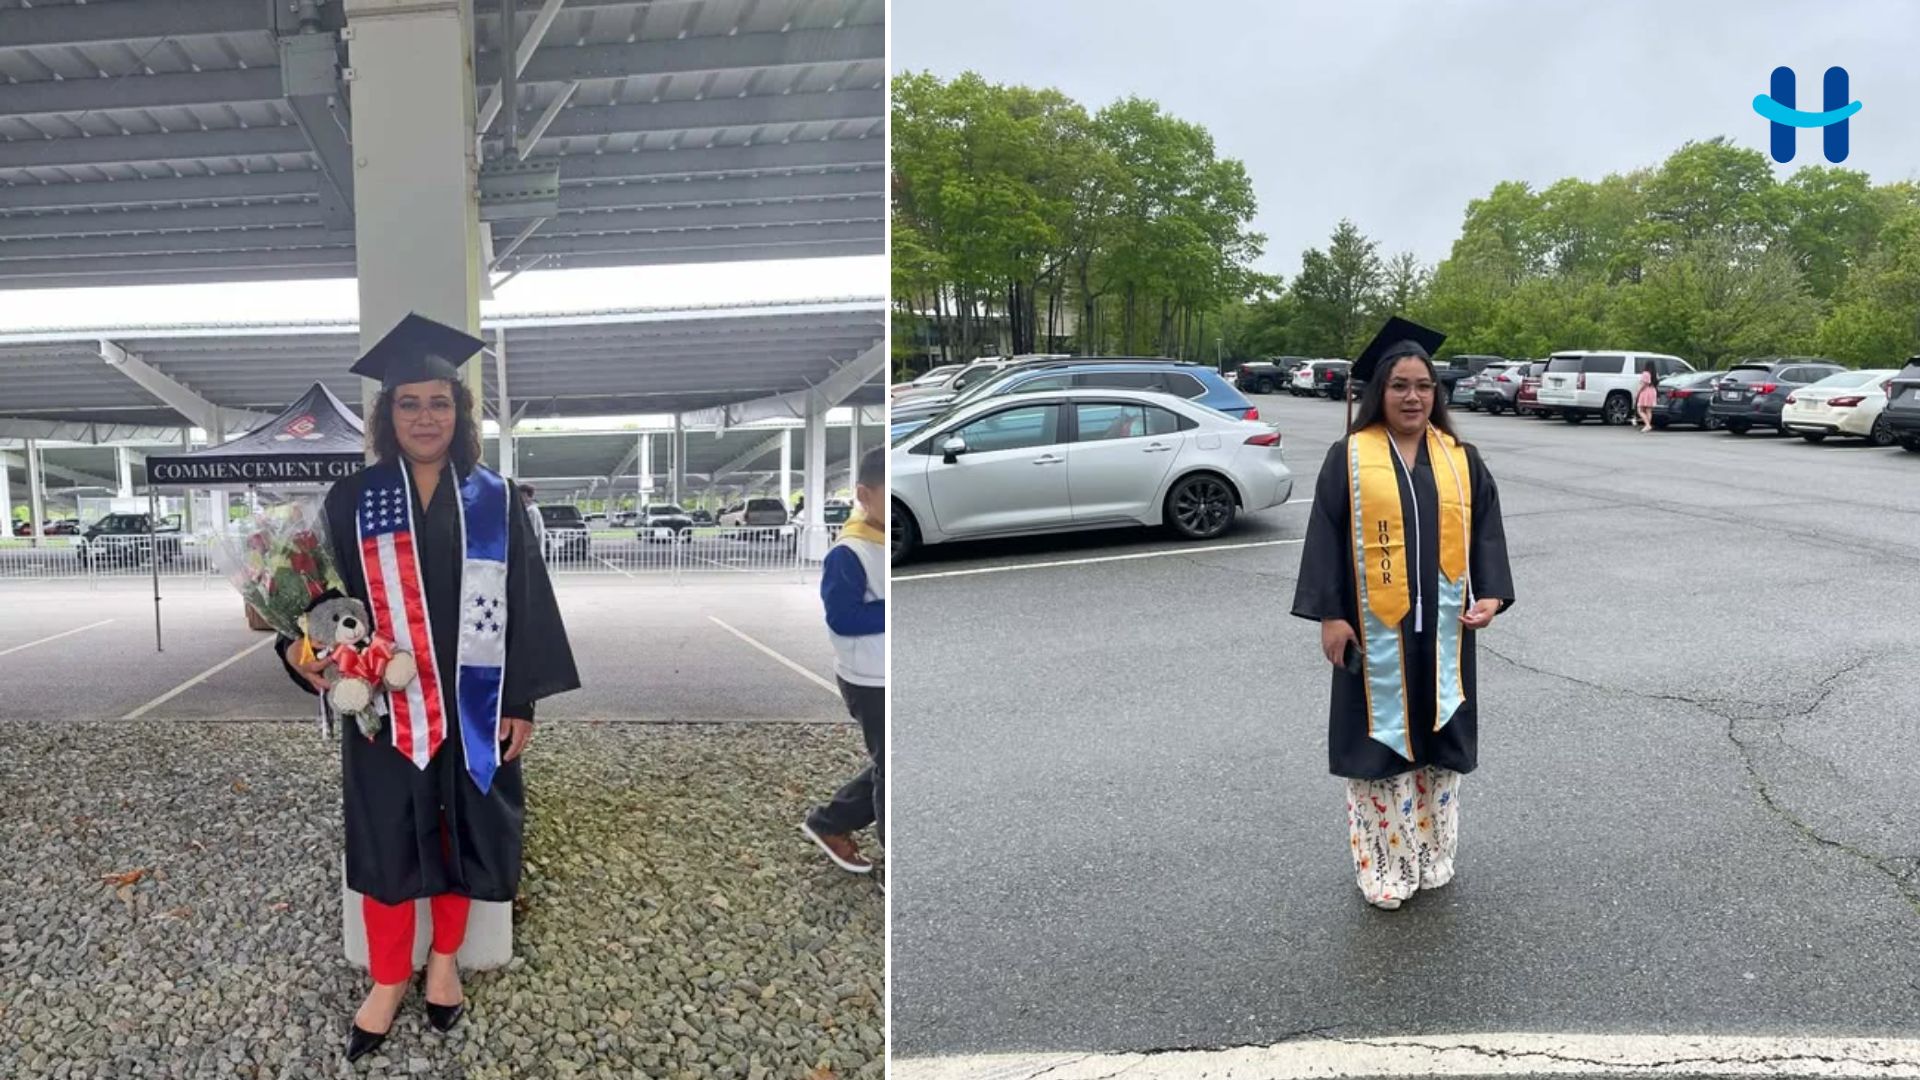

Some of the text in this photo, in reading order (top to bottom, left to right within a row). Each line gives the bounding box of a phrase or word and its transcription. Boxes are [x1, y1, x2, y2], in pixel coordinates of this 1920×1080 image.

[154, 461, 367, 479] COMMENCEMENT GIF
[1378, 520, 1391, 584] HONOR
